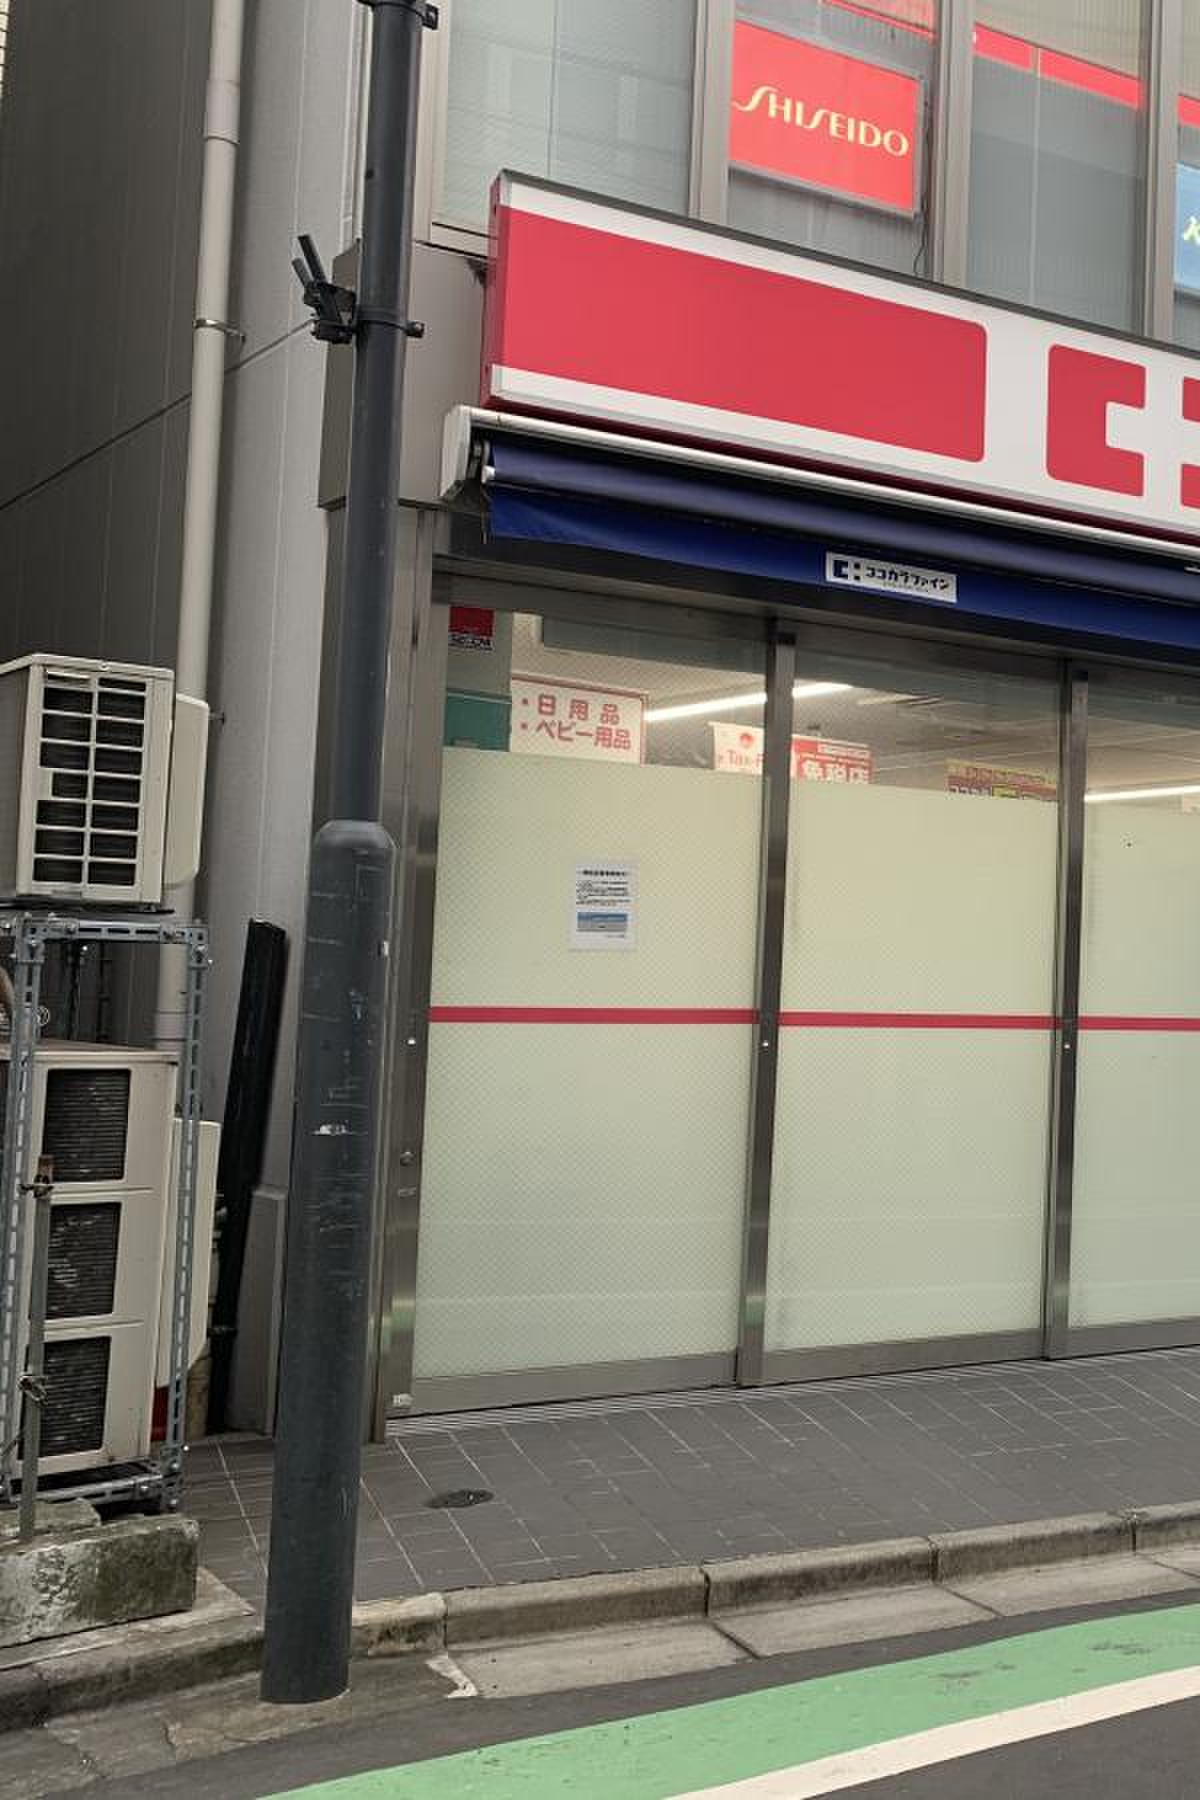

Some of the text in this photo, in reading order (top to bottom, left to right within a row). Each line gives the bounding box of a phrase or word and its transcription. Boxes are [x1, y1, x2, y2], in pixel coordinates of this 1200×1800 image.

[732, 85, 909, 156] SHISEIDO
[865, 566, 950, 591] ココカラファイン
